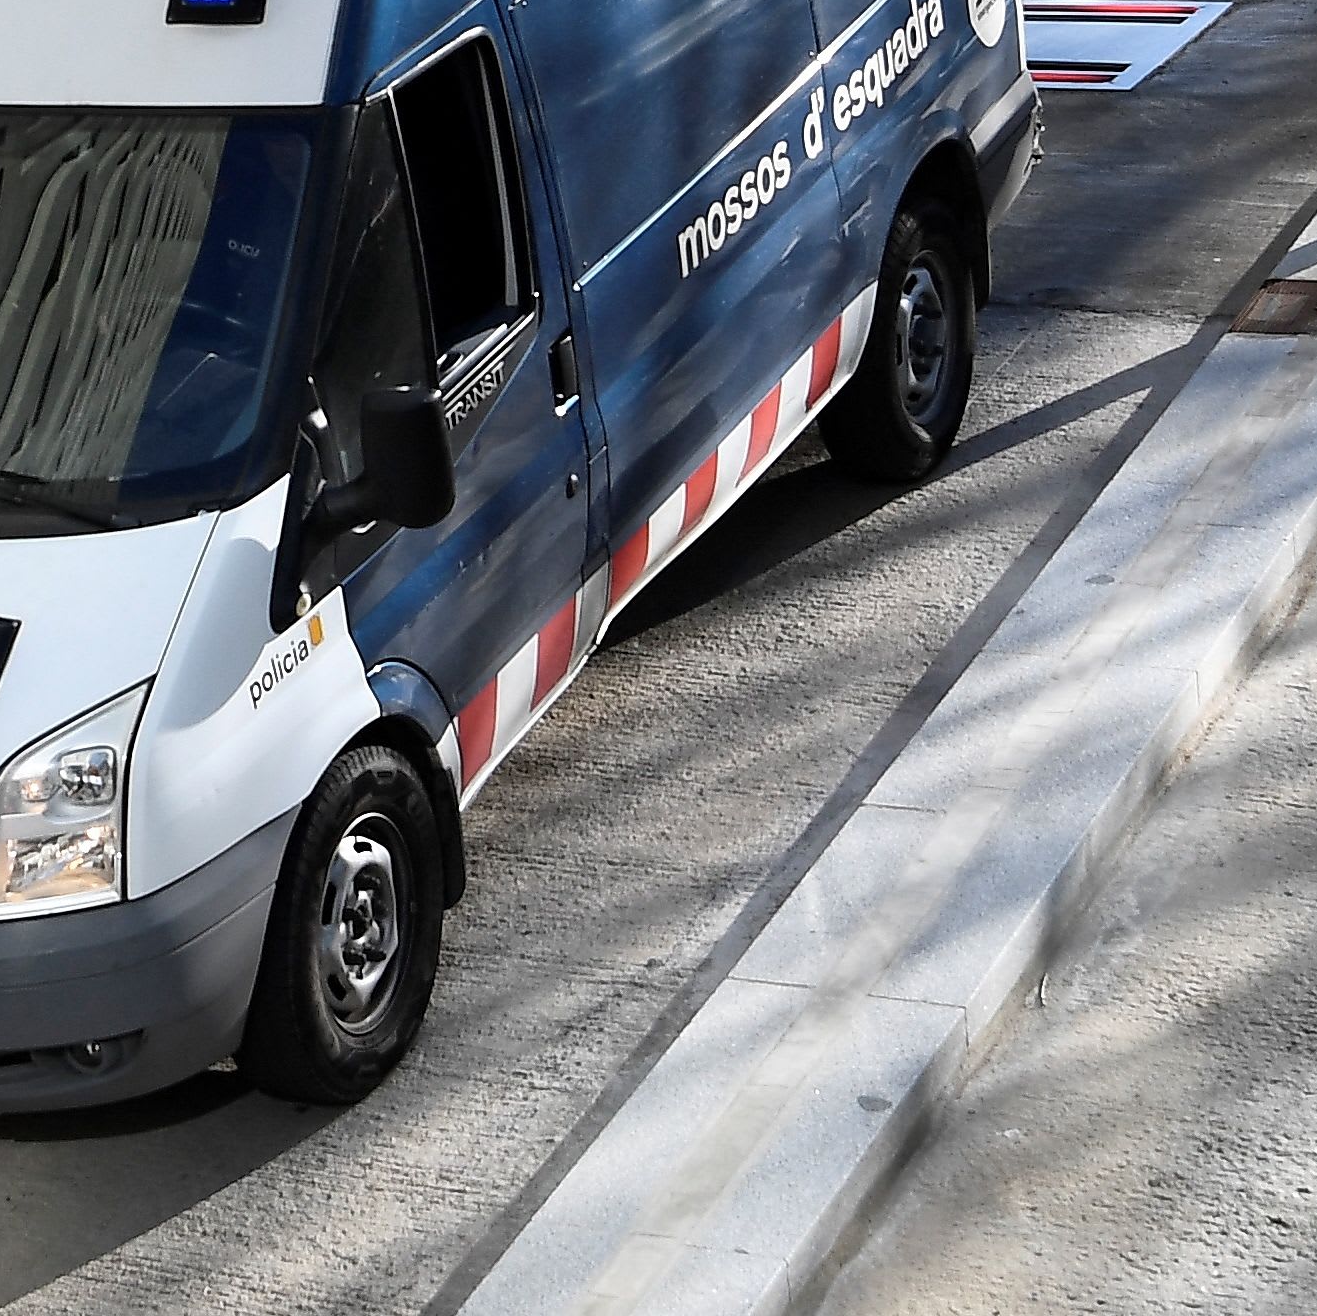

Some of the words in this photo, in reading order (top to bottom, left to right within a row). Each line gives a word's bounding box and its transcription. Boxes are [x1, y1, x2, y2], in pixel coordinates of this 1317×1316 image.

[677, 140, 792, 279] mossos
[445, 360, 505, 431] TRANSIT
[249, 639, 310, 710] policia
